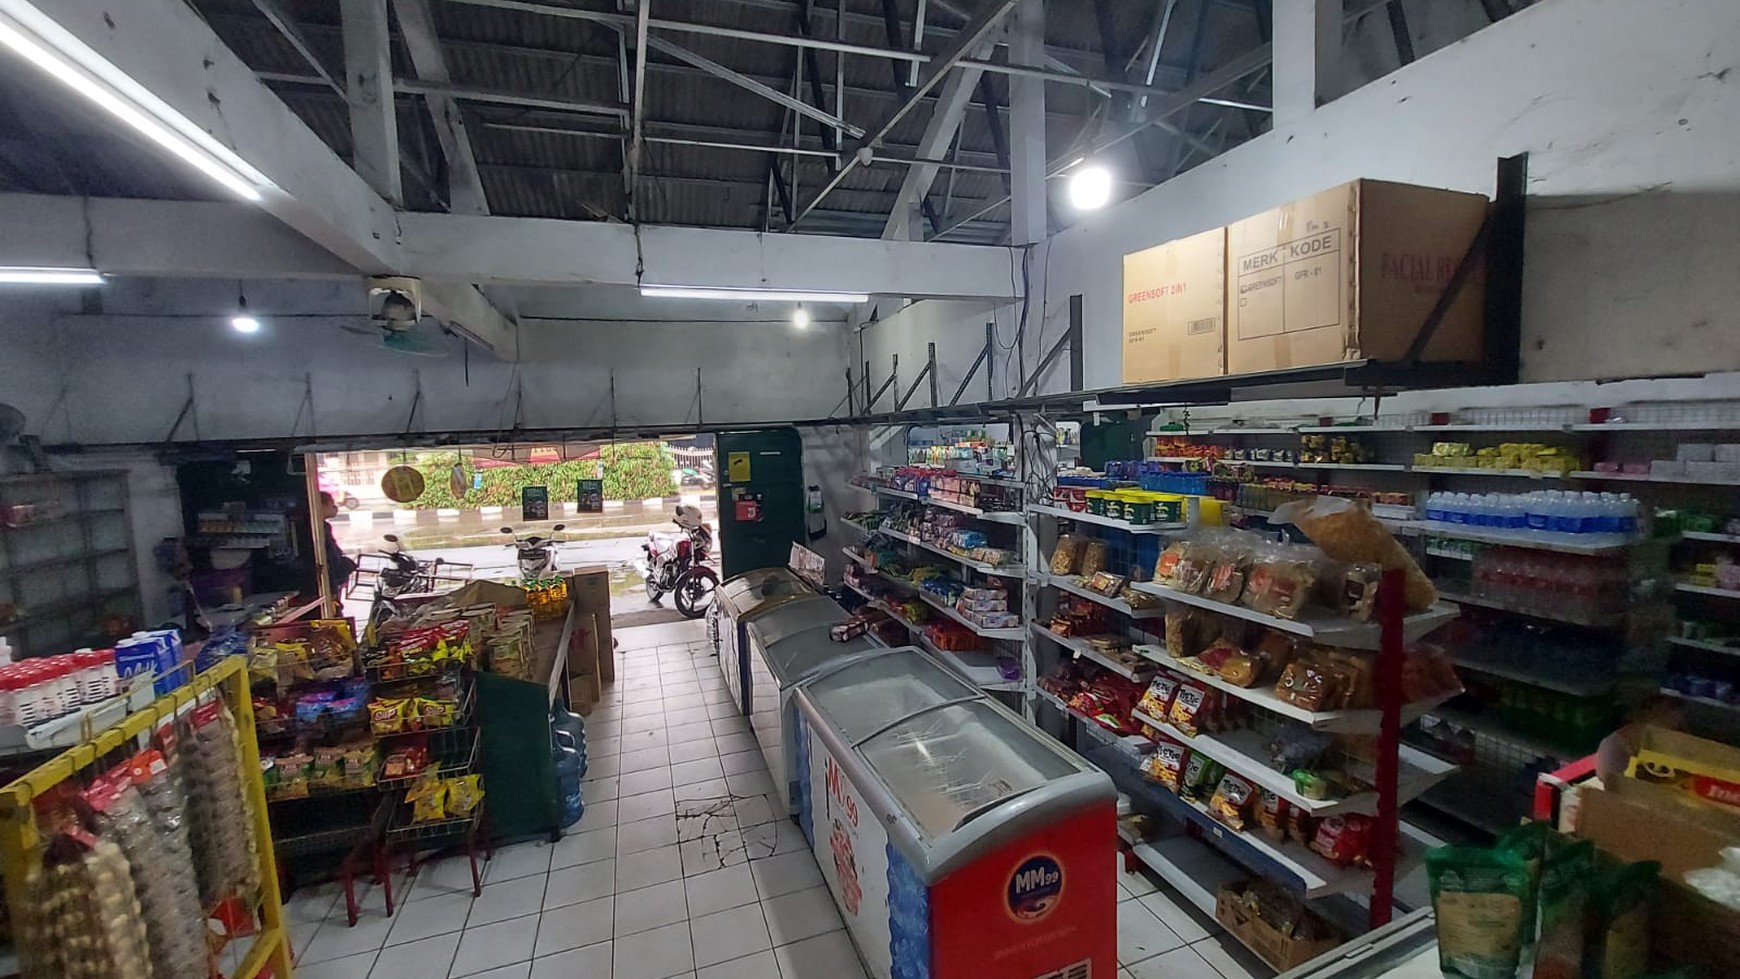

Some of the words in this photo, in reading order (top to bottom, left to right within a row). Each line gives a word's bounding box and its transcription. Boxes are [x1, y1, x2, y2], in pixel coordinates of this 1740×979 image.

[1290, 235, 1332, 258] KODE
[1243, 251, 1278, 272] MERK
[1128, 285, 1169, 304] GREENSOFT
